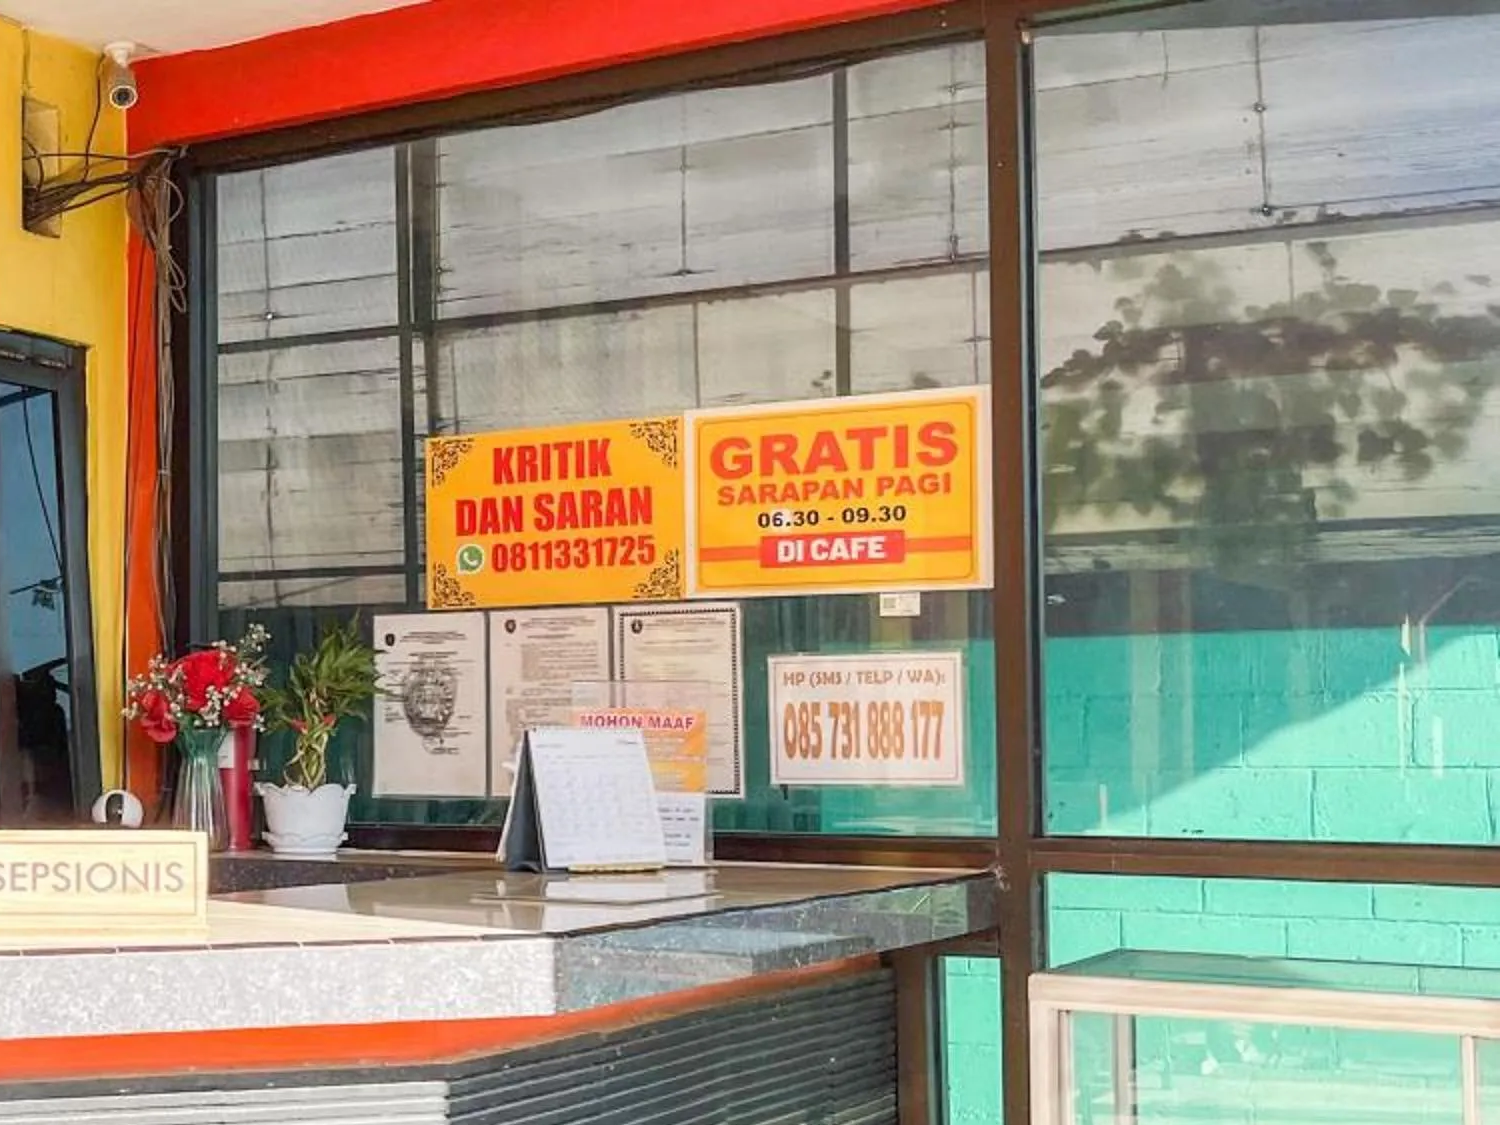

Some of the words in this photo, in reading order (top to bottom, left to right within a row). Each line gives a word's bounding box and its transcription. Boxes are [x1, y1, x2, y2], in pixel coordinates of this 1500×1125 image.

[493, 438, 611, 485] KRITIK
[710, 421, 958, 479] GRATIS
[717, 477, 866, 506] SARAPAN
[876, 472, 952, 497] PAGI
[455, 495, 524, 536] DAN
[533, 486, 653, 532] SARAN
[757, 510, 820, 530] 06.30
[841, 505, 907, 525] 09.30
[491, 535, 656, 573] 0811331725
[776, 541, 806, 564] DI
[810, 536, 888, 561] CAFE
[783, 671, 805, 686] HP
[855, 669, 893, 685] TELP
[580, 715, 643, 728] MOHON
[648, 716, 694, 729] MAAF
[783, 701, 823, 760] 085
[828, 701, 861, 760] 731
[867, 700, 905, 760] 888
[911, 700, 945, 760] 177
